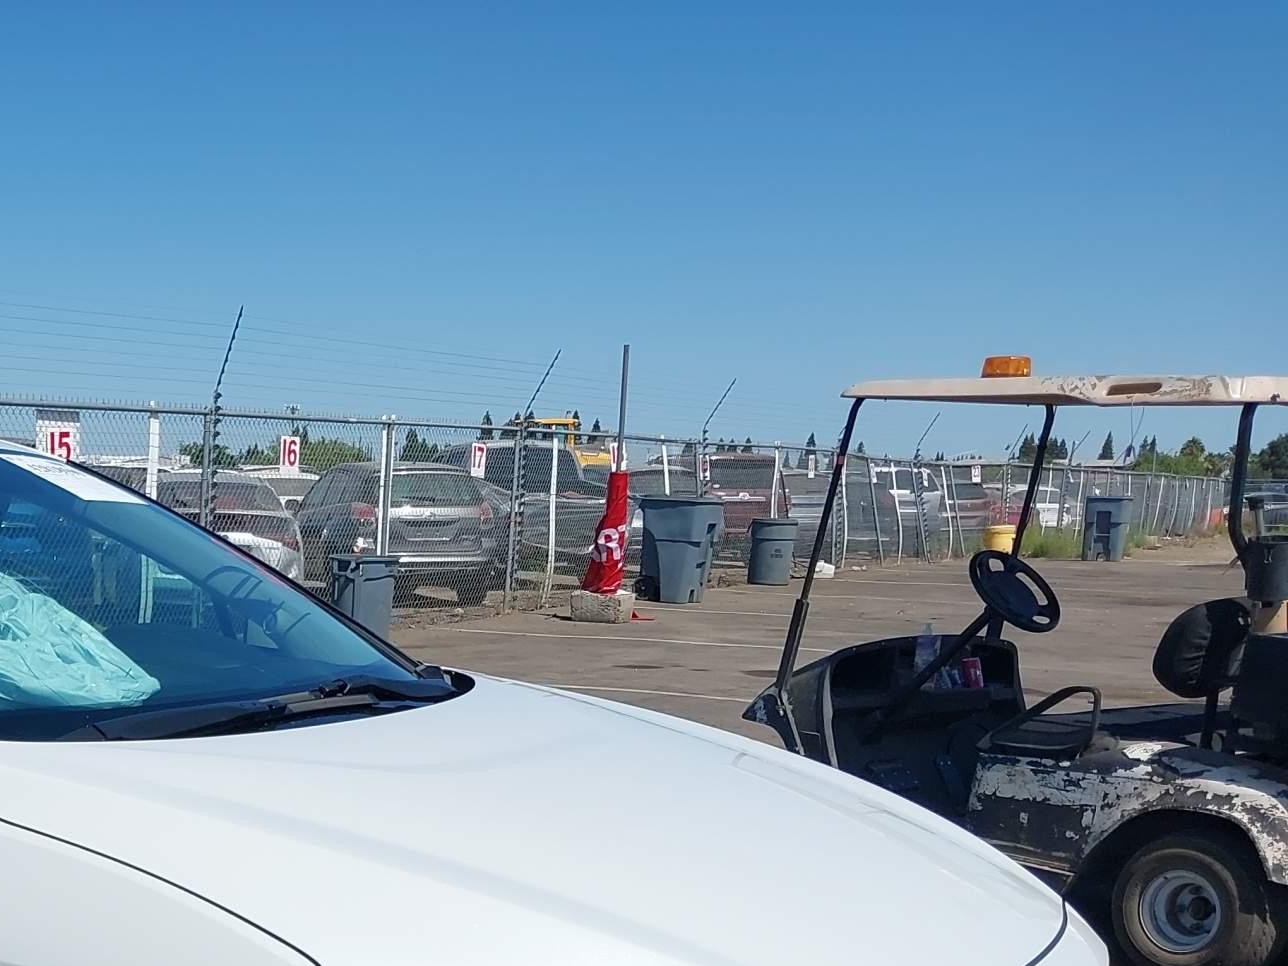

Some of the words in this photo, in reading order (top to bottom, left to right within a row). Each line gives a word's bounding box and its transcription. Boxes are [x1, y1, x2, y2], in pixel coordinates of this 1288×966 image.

[50, 431, 71, 462] 15
[282, 438, 297, 467] 16
[473, 445, 485, 469] 17
